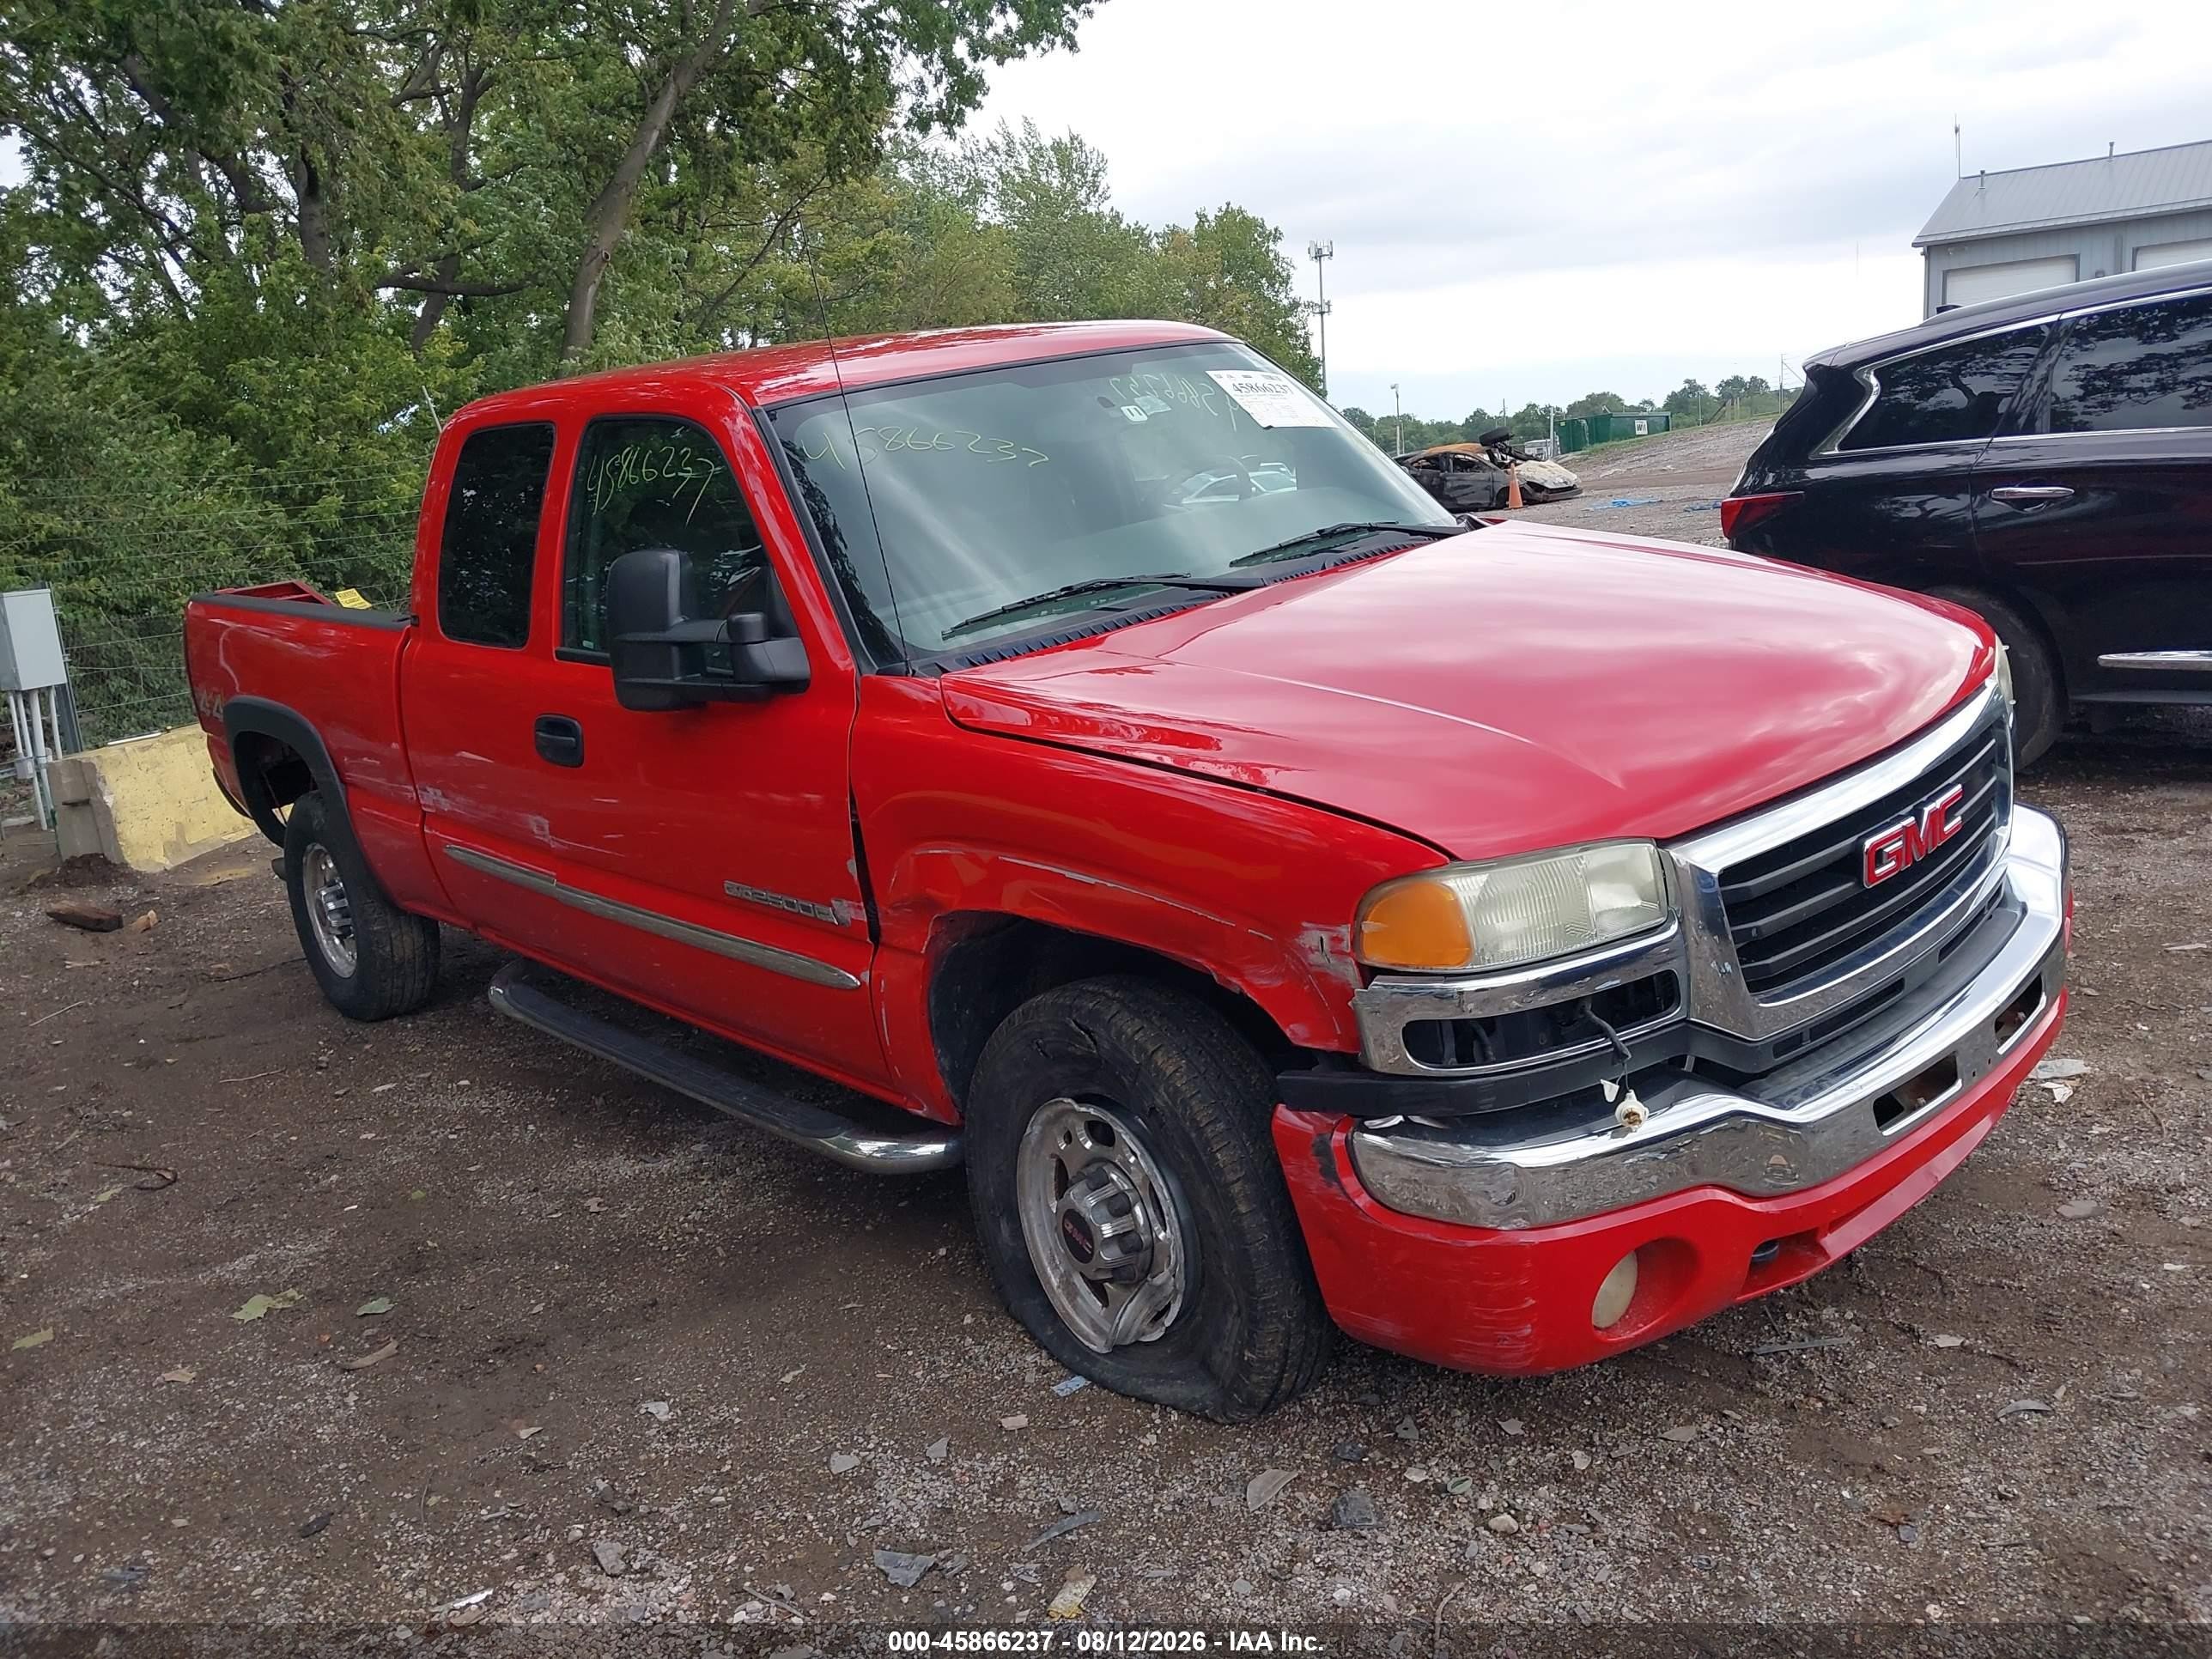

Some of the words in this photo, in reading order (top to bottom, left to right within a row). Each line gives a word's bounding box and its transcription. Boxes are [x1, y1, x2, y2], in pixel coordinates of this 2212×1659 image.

[1231, 382, 1295, 395] 45866237
[801, 426, 1049, 470] 45866237
[587, 444, 716, 528] 45866237
[1863, 783, 1965, 890] GMC
